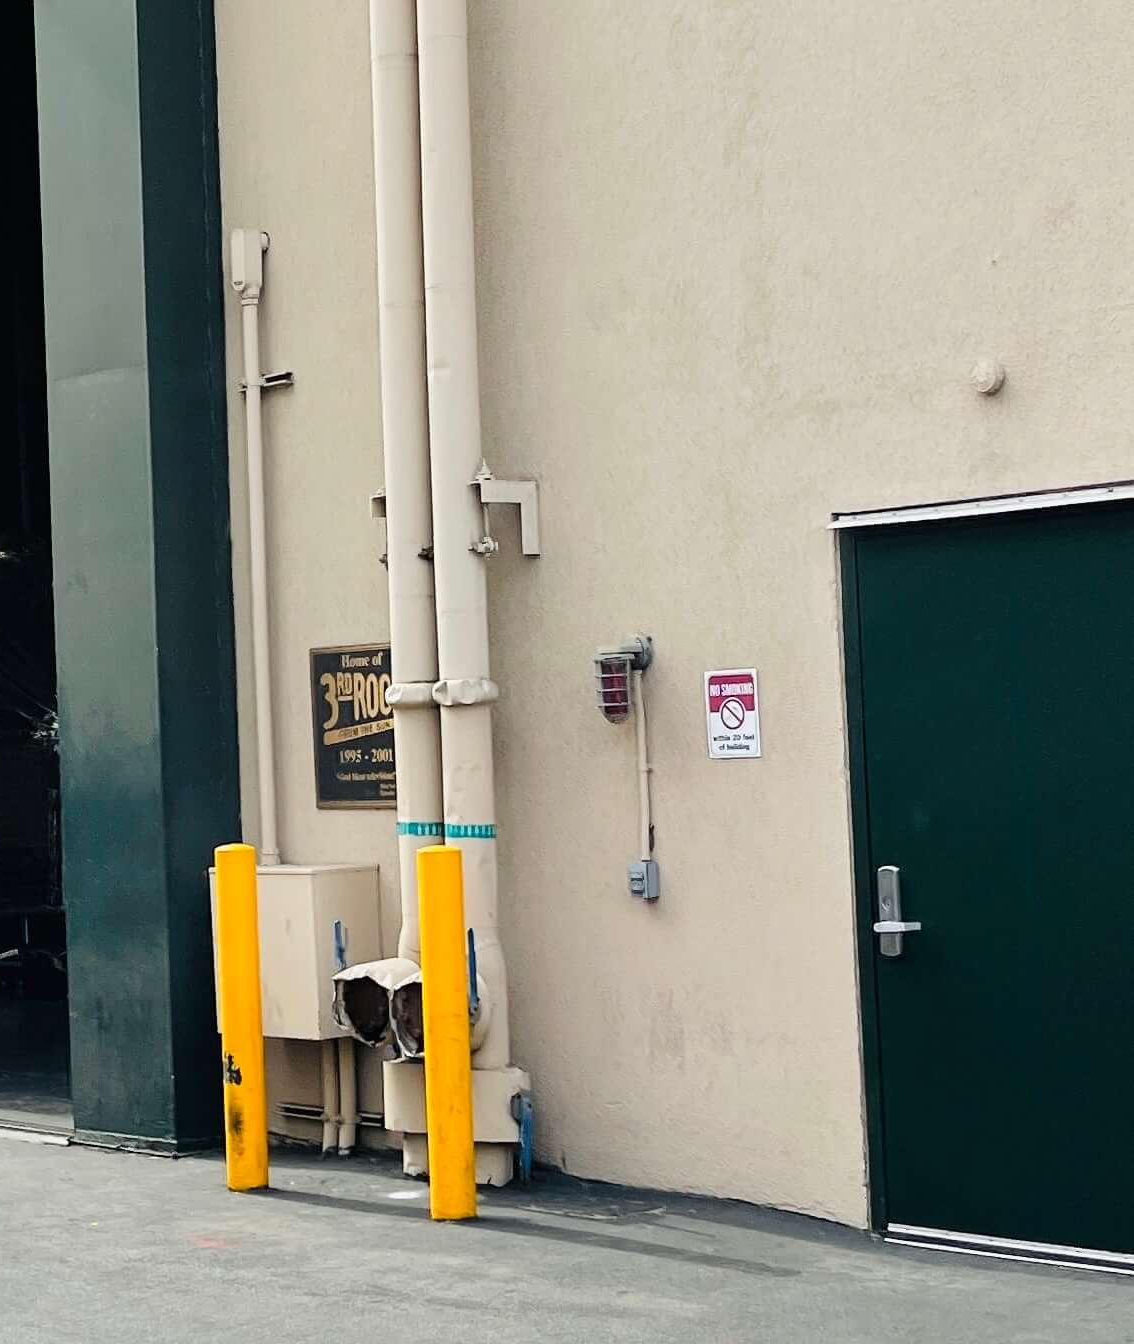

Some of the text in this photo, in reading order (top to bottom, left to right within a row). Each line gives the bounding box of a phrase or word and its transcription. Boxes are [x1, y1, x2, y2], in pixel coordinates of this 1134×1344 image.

[341, 651, 384, 668] Home of
[339, 749, 363, 764] 1995
[370, 748, 394, 763] 2001
